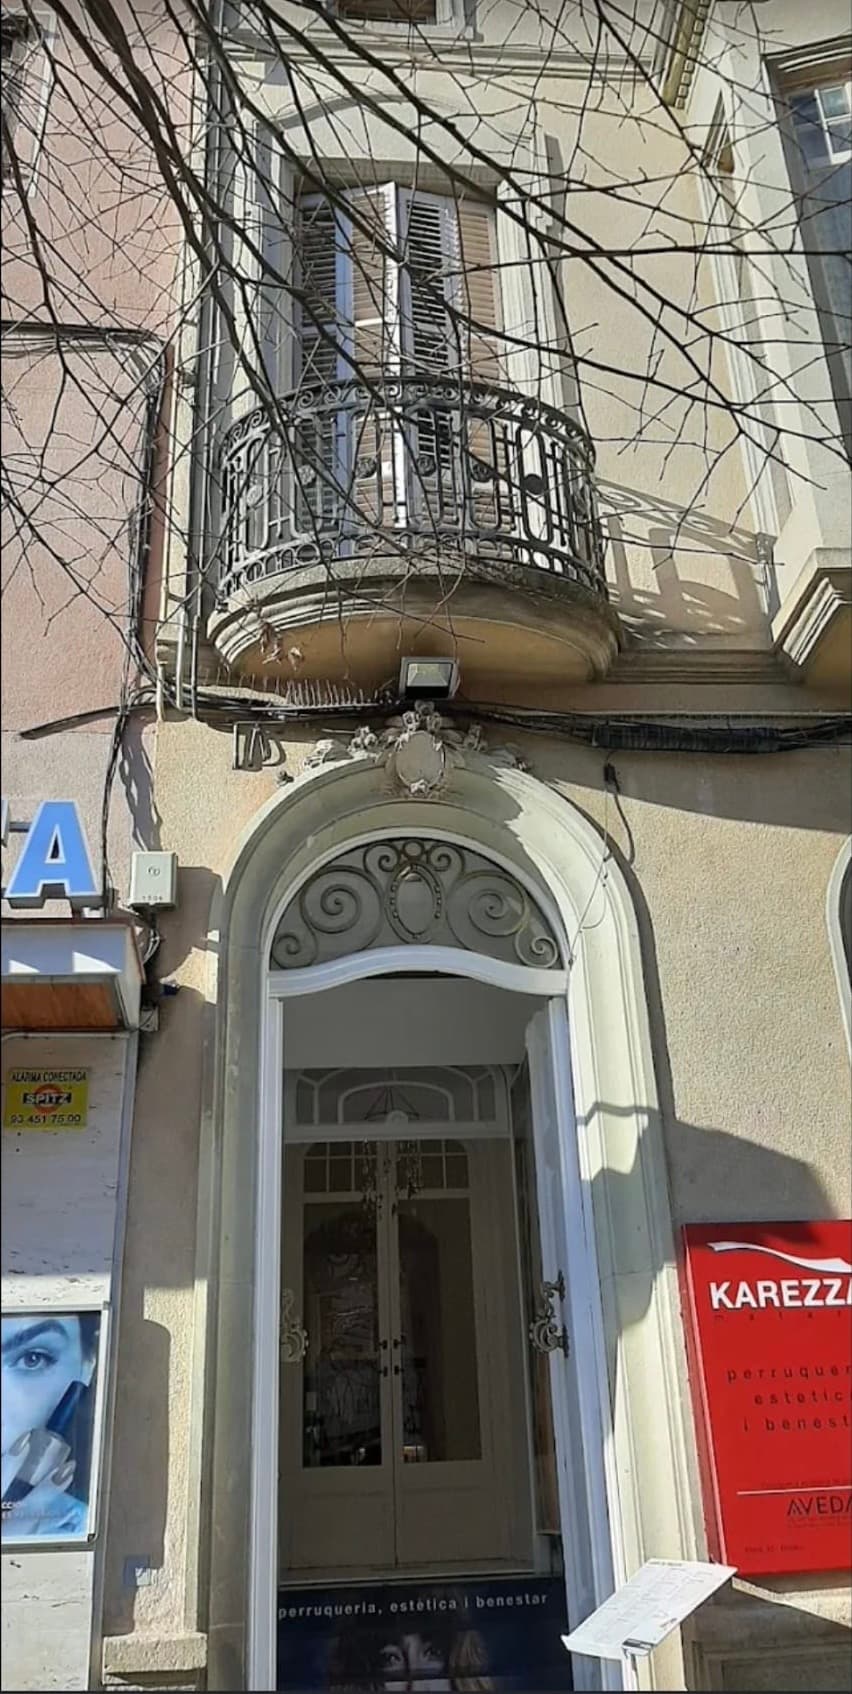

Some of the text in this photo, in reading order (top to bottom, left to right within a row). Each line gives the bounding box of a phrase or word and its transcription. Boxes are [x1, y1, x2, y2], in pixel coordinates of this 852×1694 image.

[1, 800, 99, 897] A
[11, 1071, 87, 1081] ALARMA CONECTADA
[26, 1092, 71, 1104] SPITZ
[10, 1114, 81, 1123] 93 451 75 00
[709, 1278, 851, 1310] KAREZZ
[754, 1389, 851, 1405] estetic
[743, 1418, 749, 1431] i
[278, 1602, 383, 1619] perruqueria,
[476, 1593, 547, 1609] benestar
